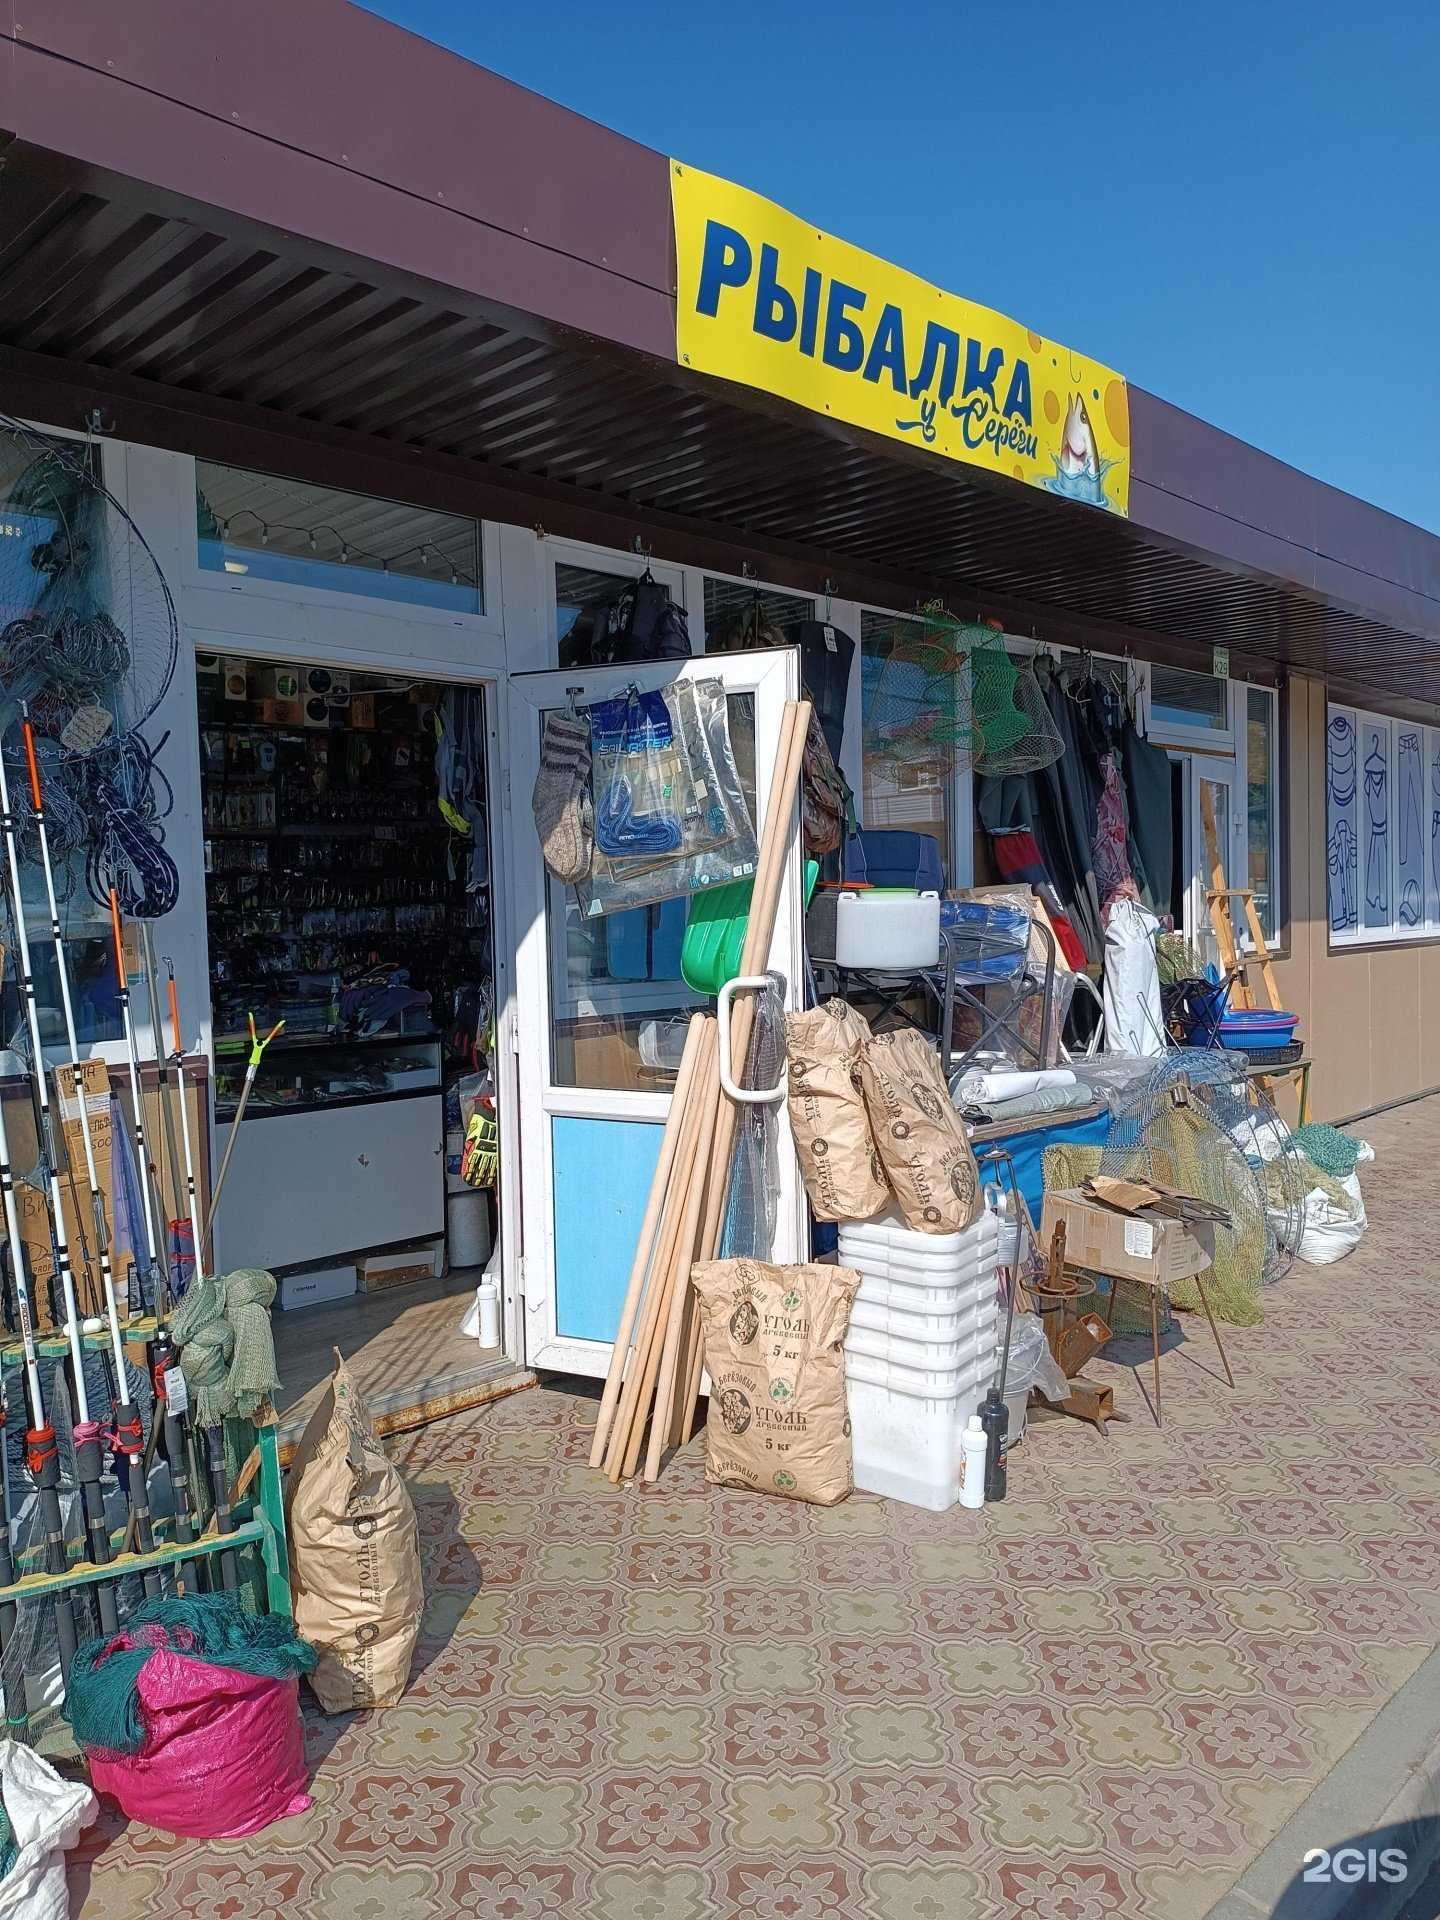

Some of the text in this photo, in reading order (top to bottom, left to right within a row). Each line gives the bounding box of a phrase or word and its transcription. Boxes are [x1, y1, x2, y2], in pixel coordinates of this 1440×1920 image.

[695, 219, 1033, 427] РЫБАЛКА
[764, 1314, 810, 1333] УГОЛЬ
[772, 1344, 782, 1357] 5
[755, 1406, 808, 1424] УГОЛЬ
[765, 1438, 773, 1450] 5
